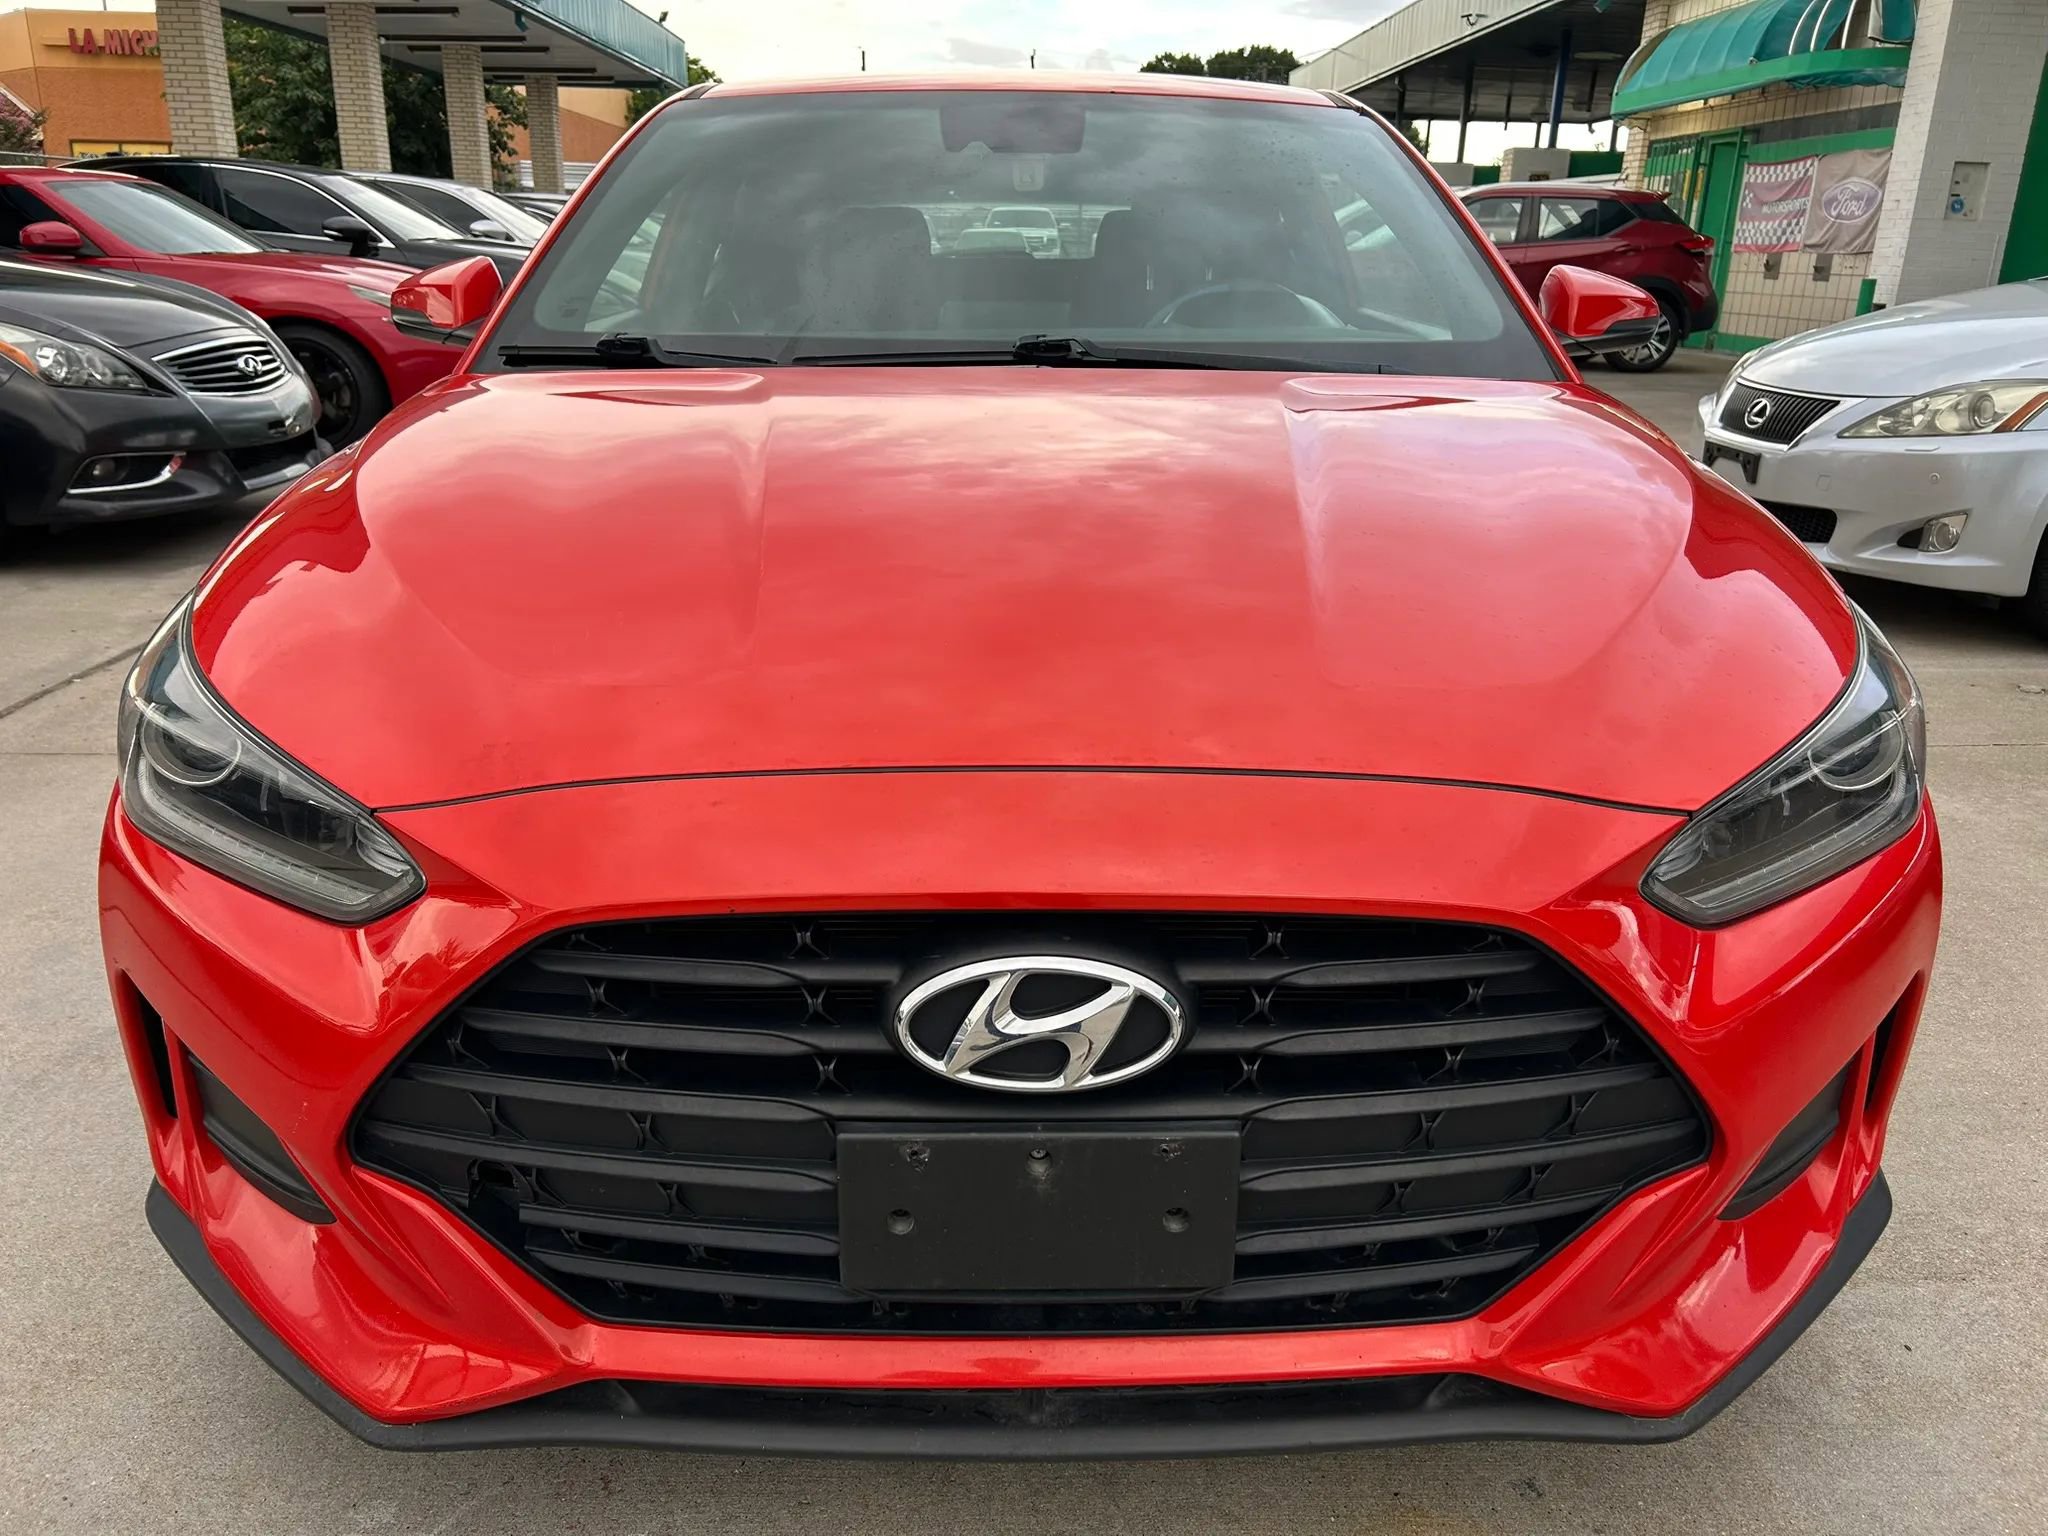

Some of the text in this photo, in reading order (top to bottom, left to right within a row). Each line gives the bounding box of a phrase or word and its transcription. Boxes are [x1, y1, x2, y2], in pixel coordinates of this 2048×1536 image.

[68, 28, 97, 54] LA
[1761, 198, 1810, 214] MOTORSPORTS
[1831, 184, 1868, 217] Ford
